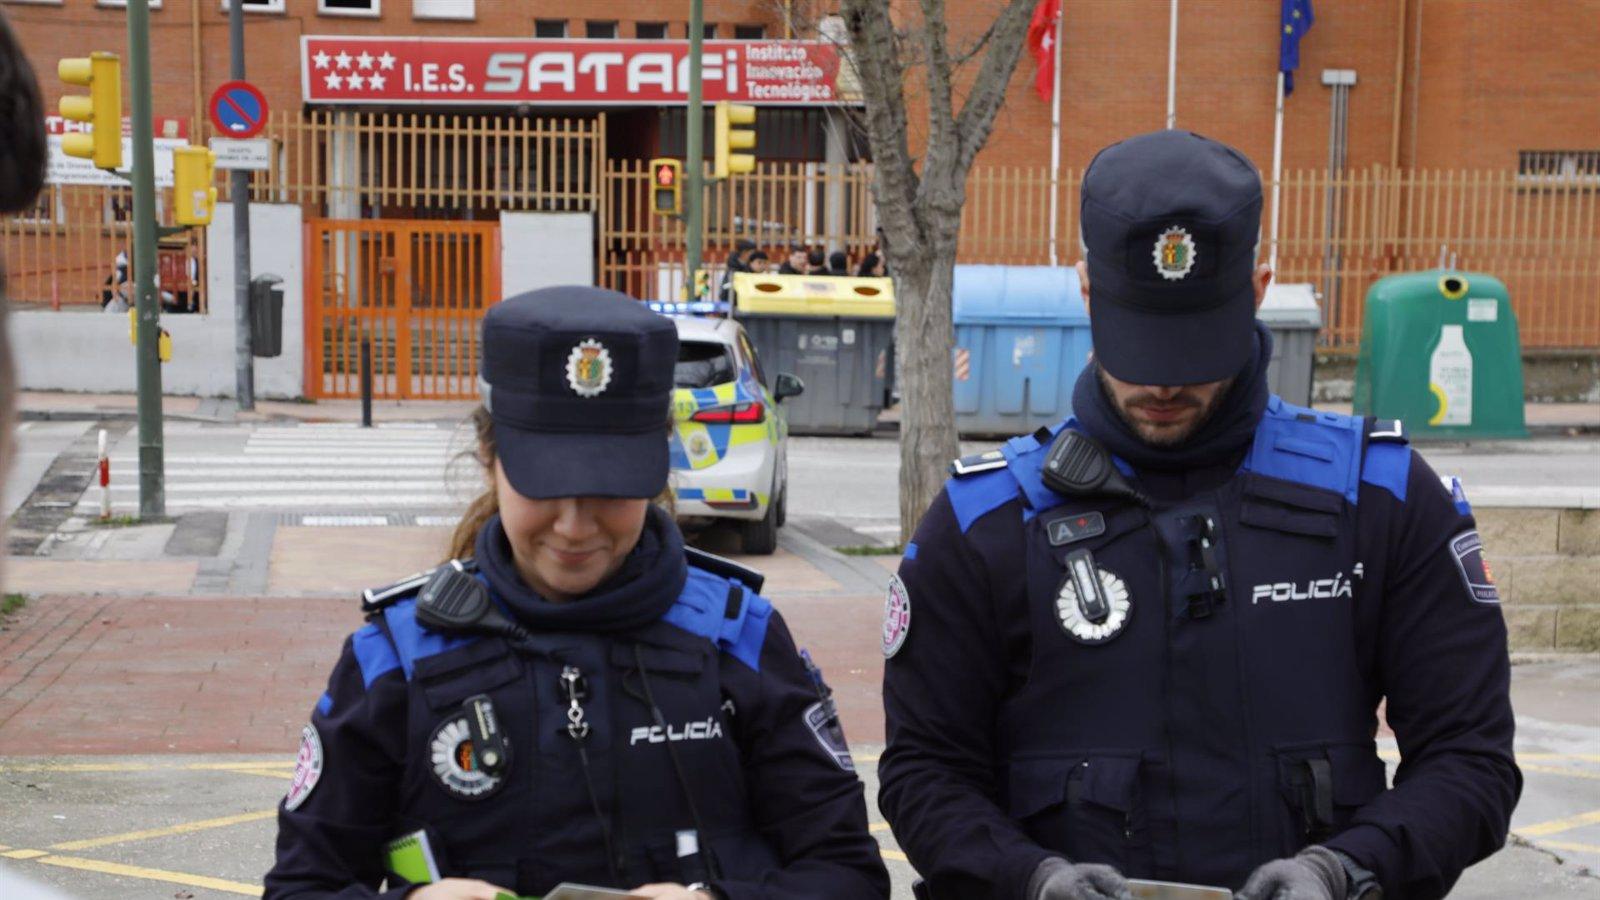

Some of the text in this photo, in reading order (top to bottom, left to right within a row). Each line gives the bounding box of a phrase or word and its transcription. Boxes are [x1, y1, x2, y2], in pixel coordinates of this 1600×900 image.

[746, 44, 807, 60] Instituto
[403, 63, 474, 92] I.E.S.
[746, 61, 823, 79] Innovación
[746, 81, 831, 101] Tecnológica
[1252, 571, 1352, 604] POLICÍA
